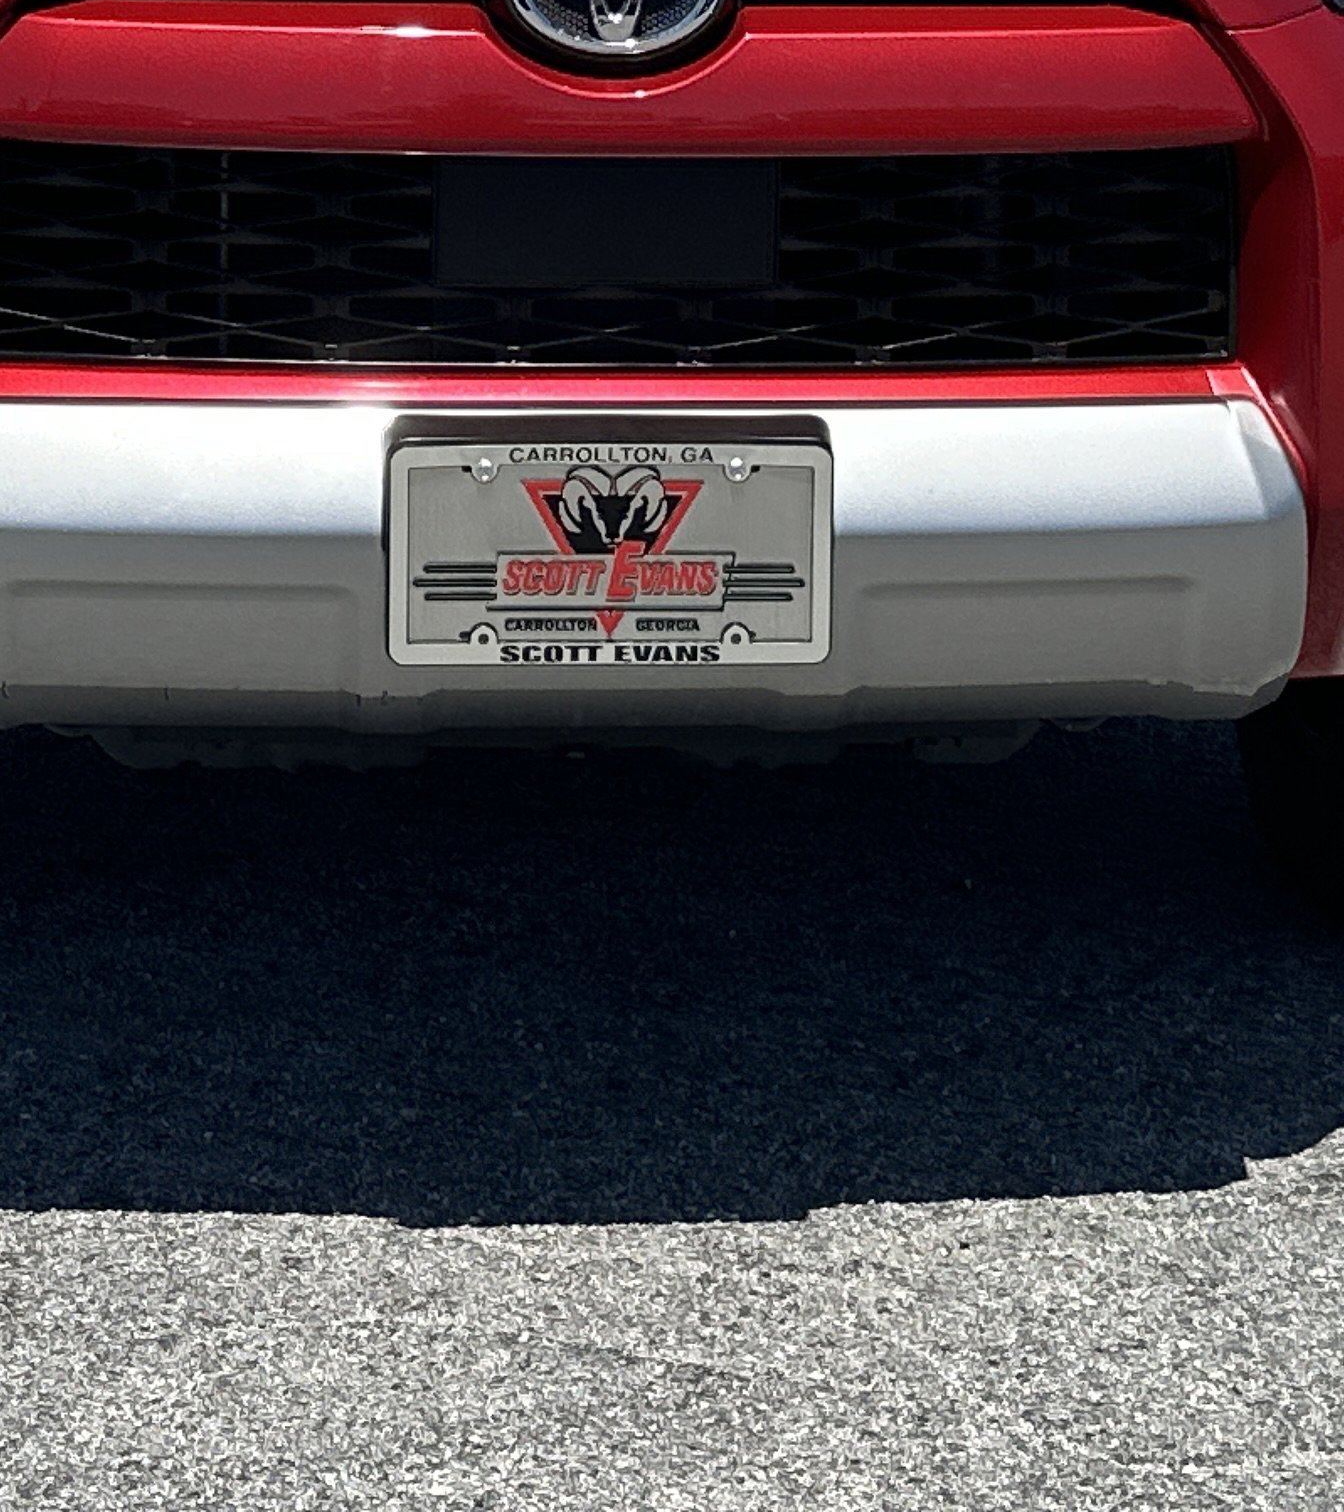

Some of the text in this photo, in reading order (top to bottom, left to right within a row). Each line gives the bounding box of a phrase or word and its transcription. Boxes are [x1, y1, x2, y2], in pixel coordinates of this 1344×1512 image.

[509, 447, 714, 463] CARROLLTON, GA
[503, 540, 719, 602] SCOTT EVANS
[505, 618, 700, 631] CARROLLTON GEORGIA
[500, 645, 720, 662] SCOTT EVANS
